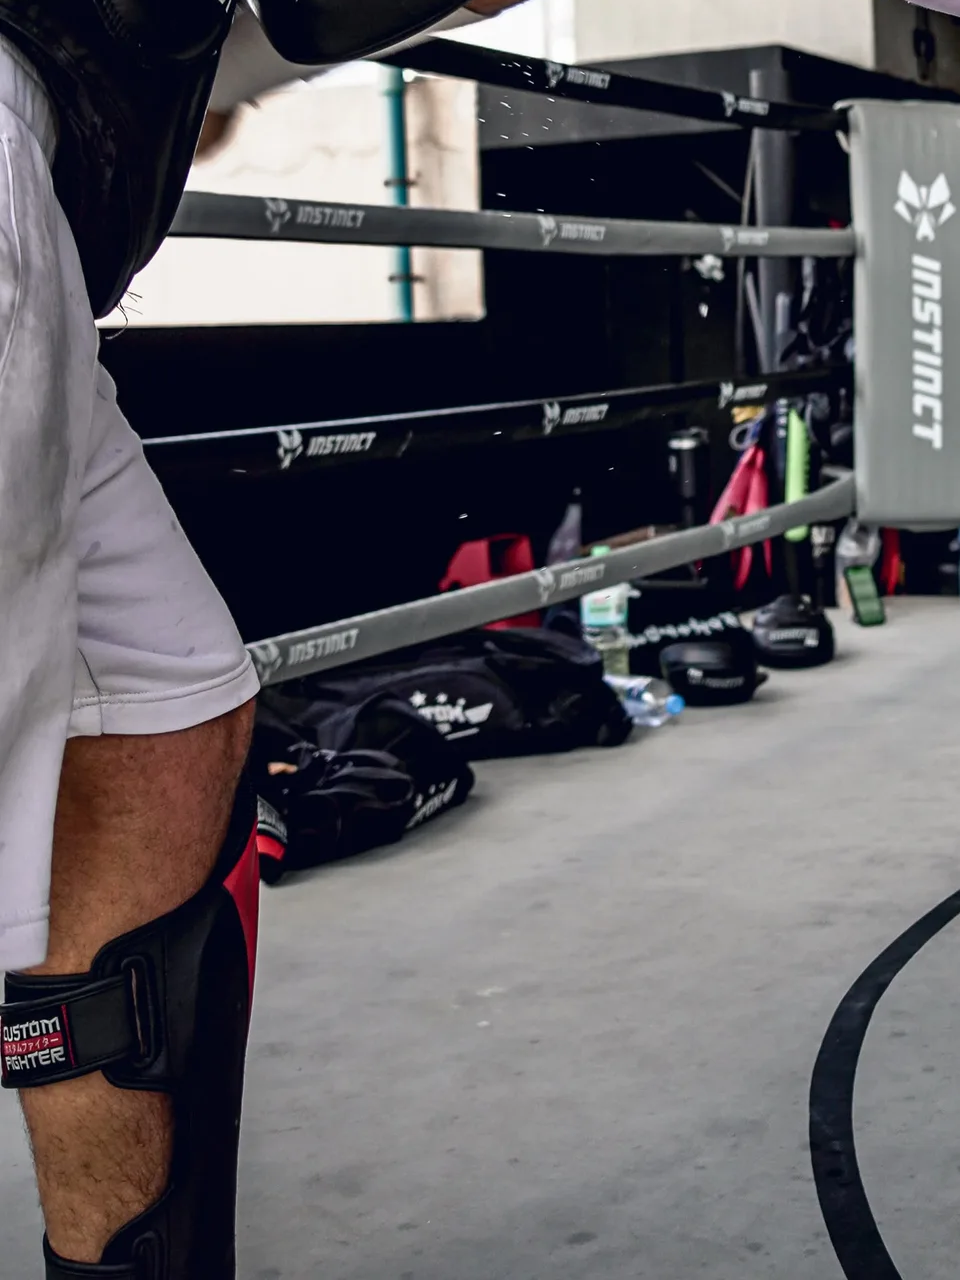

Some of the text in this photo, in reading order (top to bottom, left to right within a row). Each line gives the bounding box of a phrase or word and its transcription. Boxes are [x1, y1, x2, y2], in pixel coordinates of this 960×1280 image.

[296, 206, 365, 228] INSTINCT
[911, 253, 942, 450] INSTINCT
[306, 431, 377, 457] INSTINCT
[287, 628, 359, 666] INSTINCT
[3, 1016, 61, 1042] CUSTOM
[5, 1046, 66, 1071] FIGHTER
